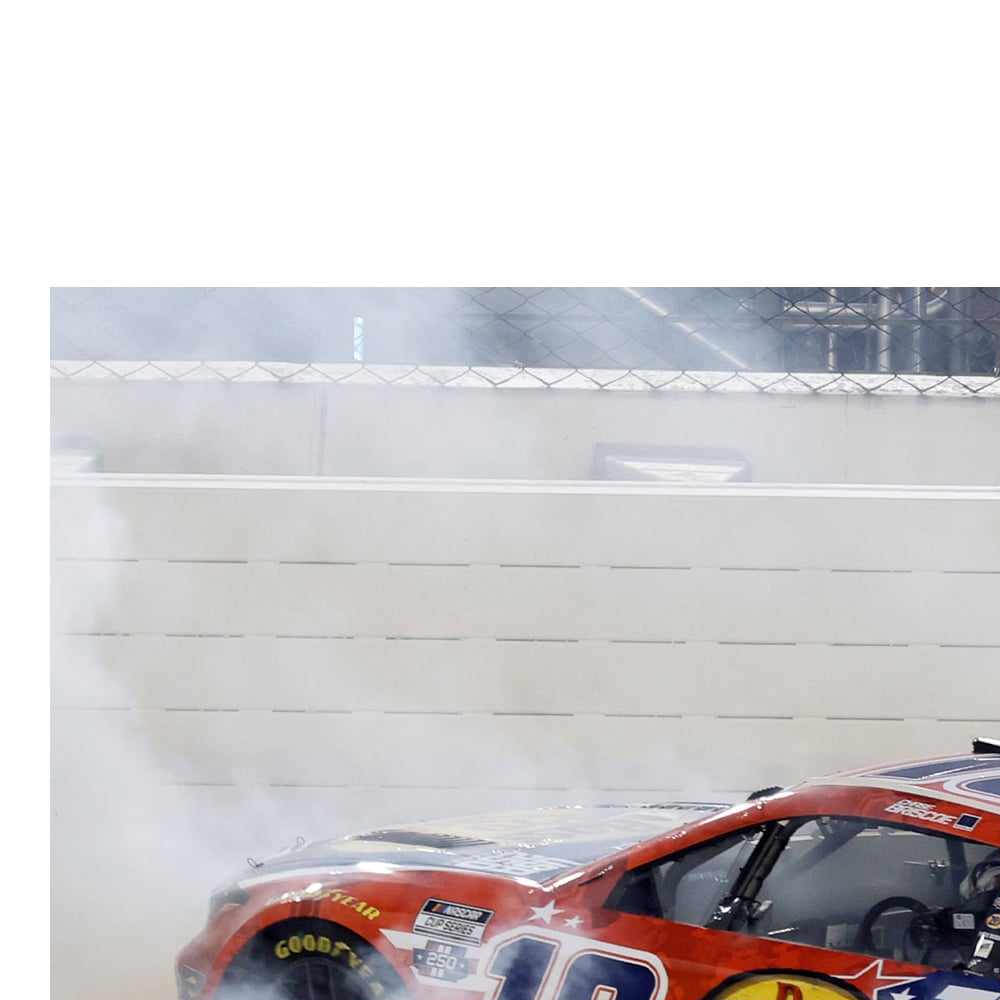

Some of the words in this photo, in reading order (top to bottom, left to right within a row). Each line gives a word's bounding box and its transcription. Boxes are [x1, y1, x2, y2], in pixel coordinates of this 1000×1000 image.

[884, 804, 958, 825] BRISCOE
[424, 917, 445, 928] CUP
[443, 920, 477, 936] SERIES
[425, 951, 458, 970] 250
